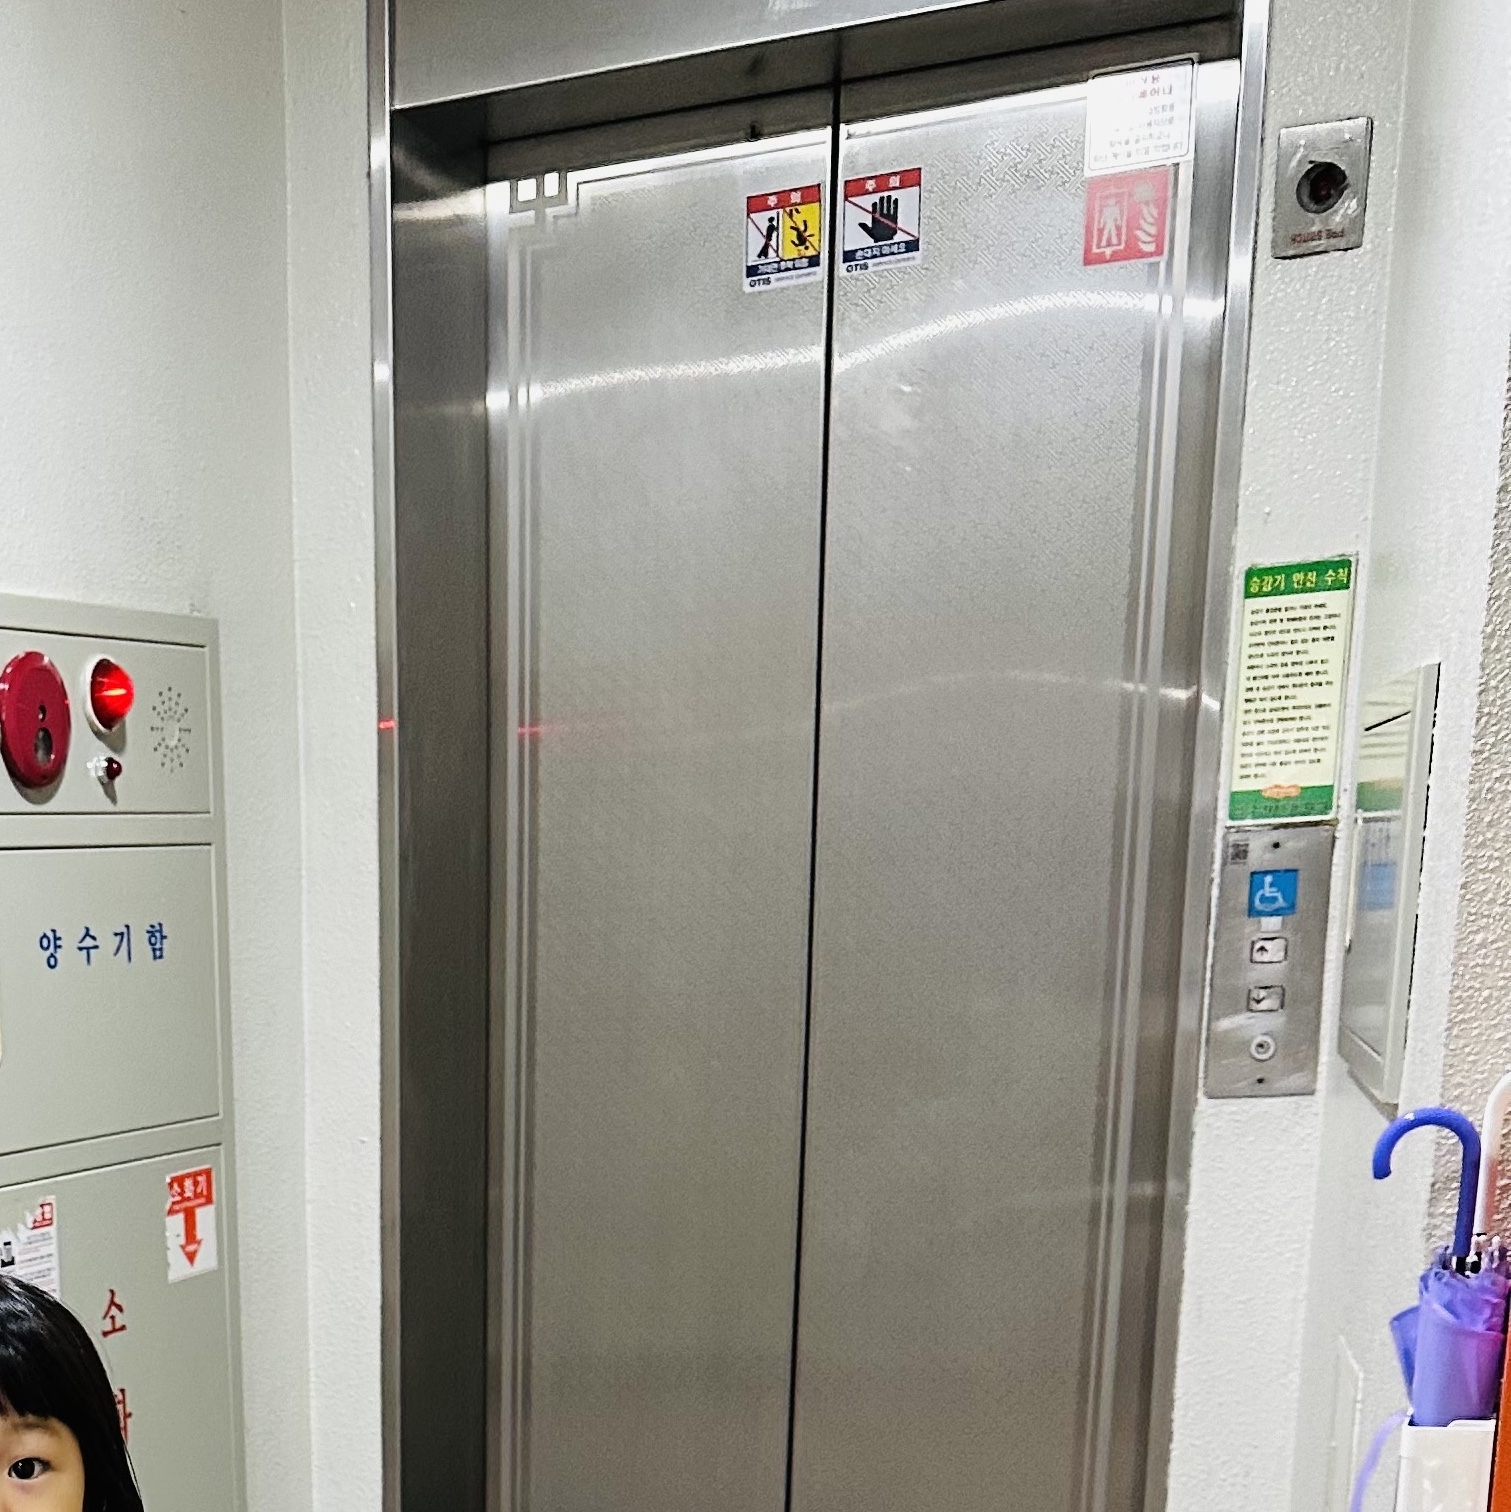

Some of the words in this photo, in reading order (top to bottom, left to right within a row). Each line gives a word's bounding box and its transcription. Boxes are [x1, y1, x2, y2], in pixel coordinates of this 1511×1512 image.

[1249, 573, 1285, 593] 승강기
[1292, 571, 1317, 589] 안전
[1324, 567, 1349, 586] 수칙
[39, 922, 168, 970] 양수기함
[170, 1173, 207, 1202] 소화기
